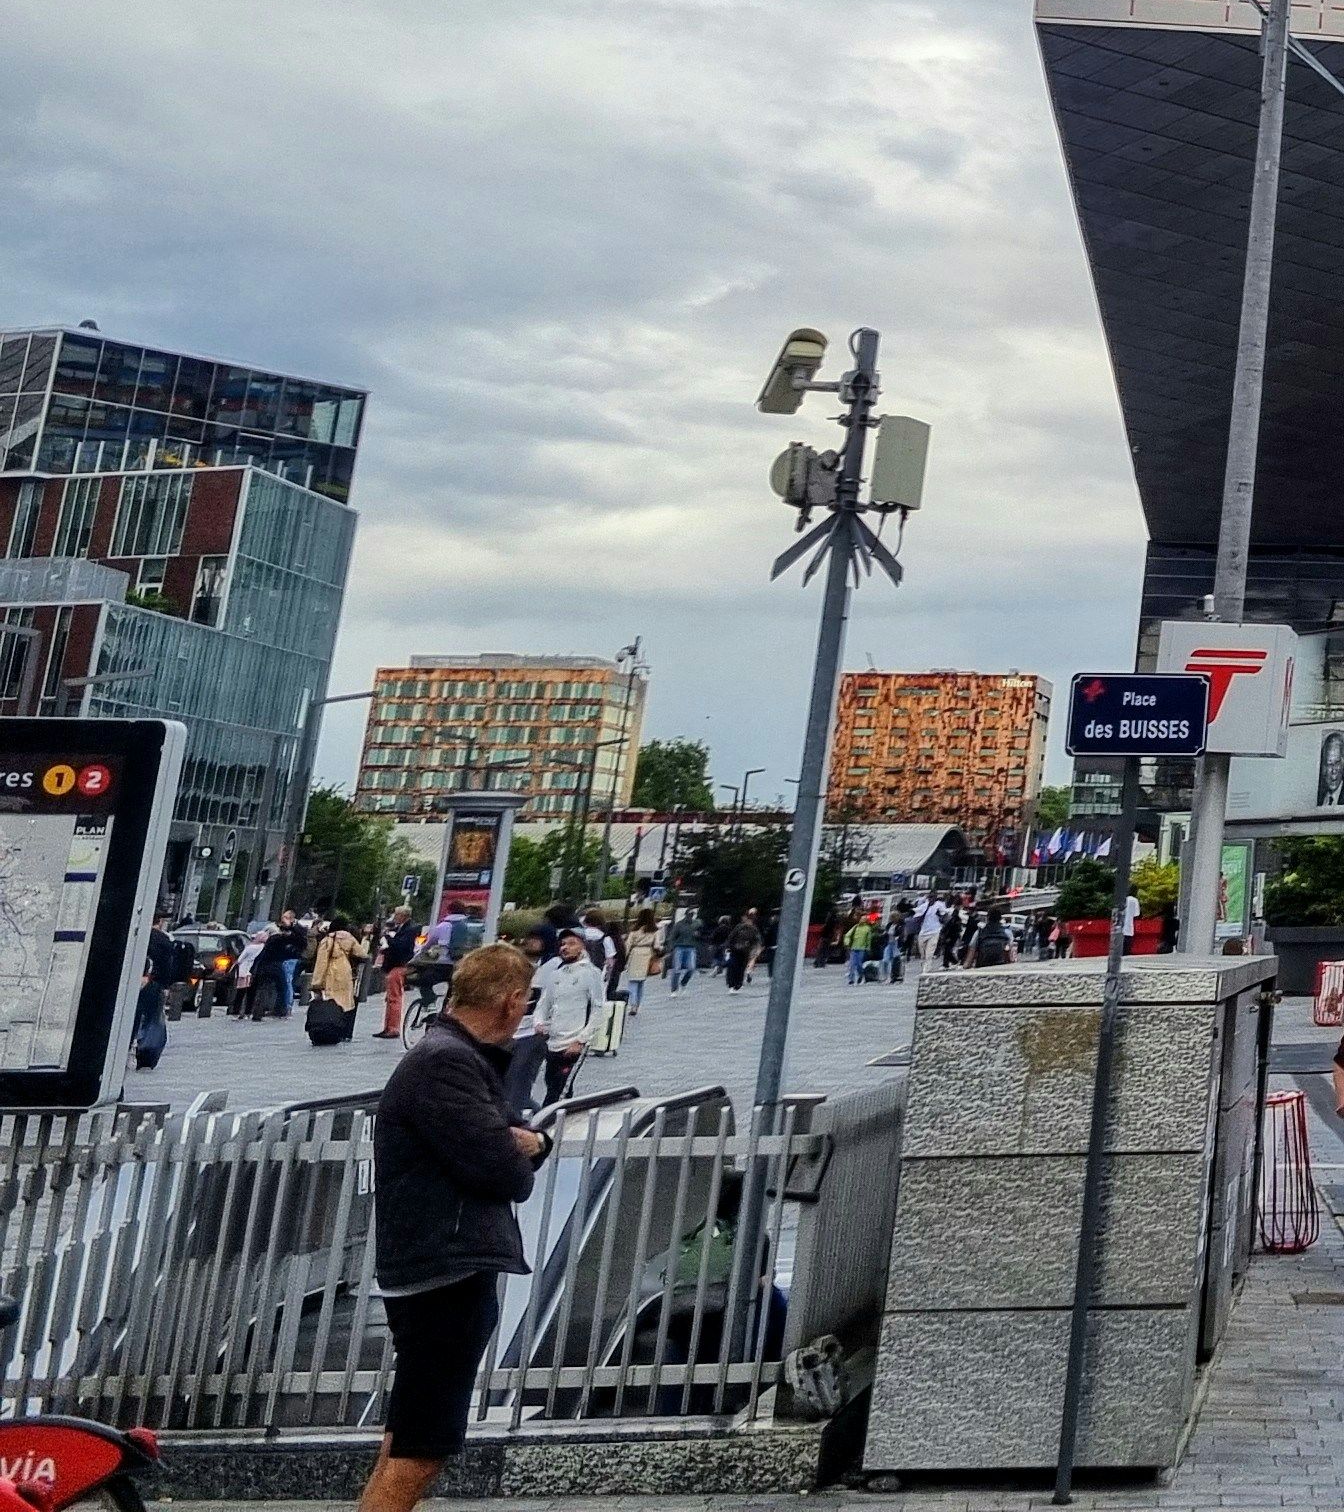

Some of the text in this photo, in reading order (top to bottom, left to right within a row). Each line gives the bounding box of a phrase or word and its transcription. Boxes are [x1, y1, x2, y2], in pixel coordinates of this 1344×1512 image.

[1122, 691, 1157, 706] Place
[1084, 719, 1190, 739] des BUISSES
